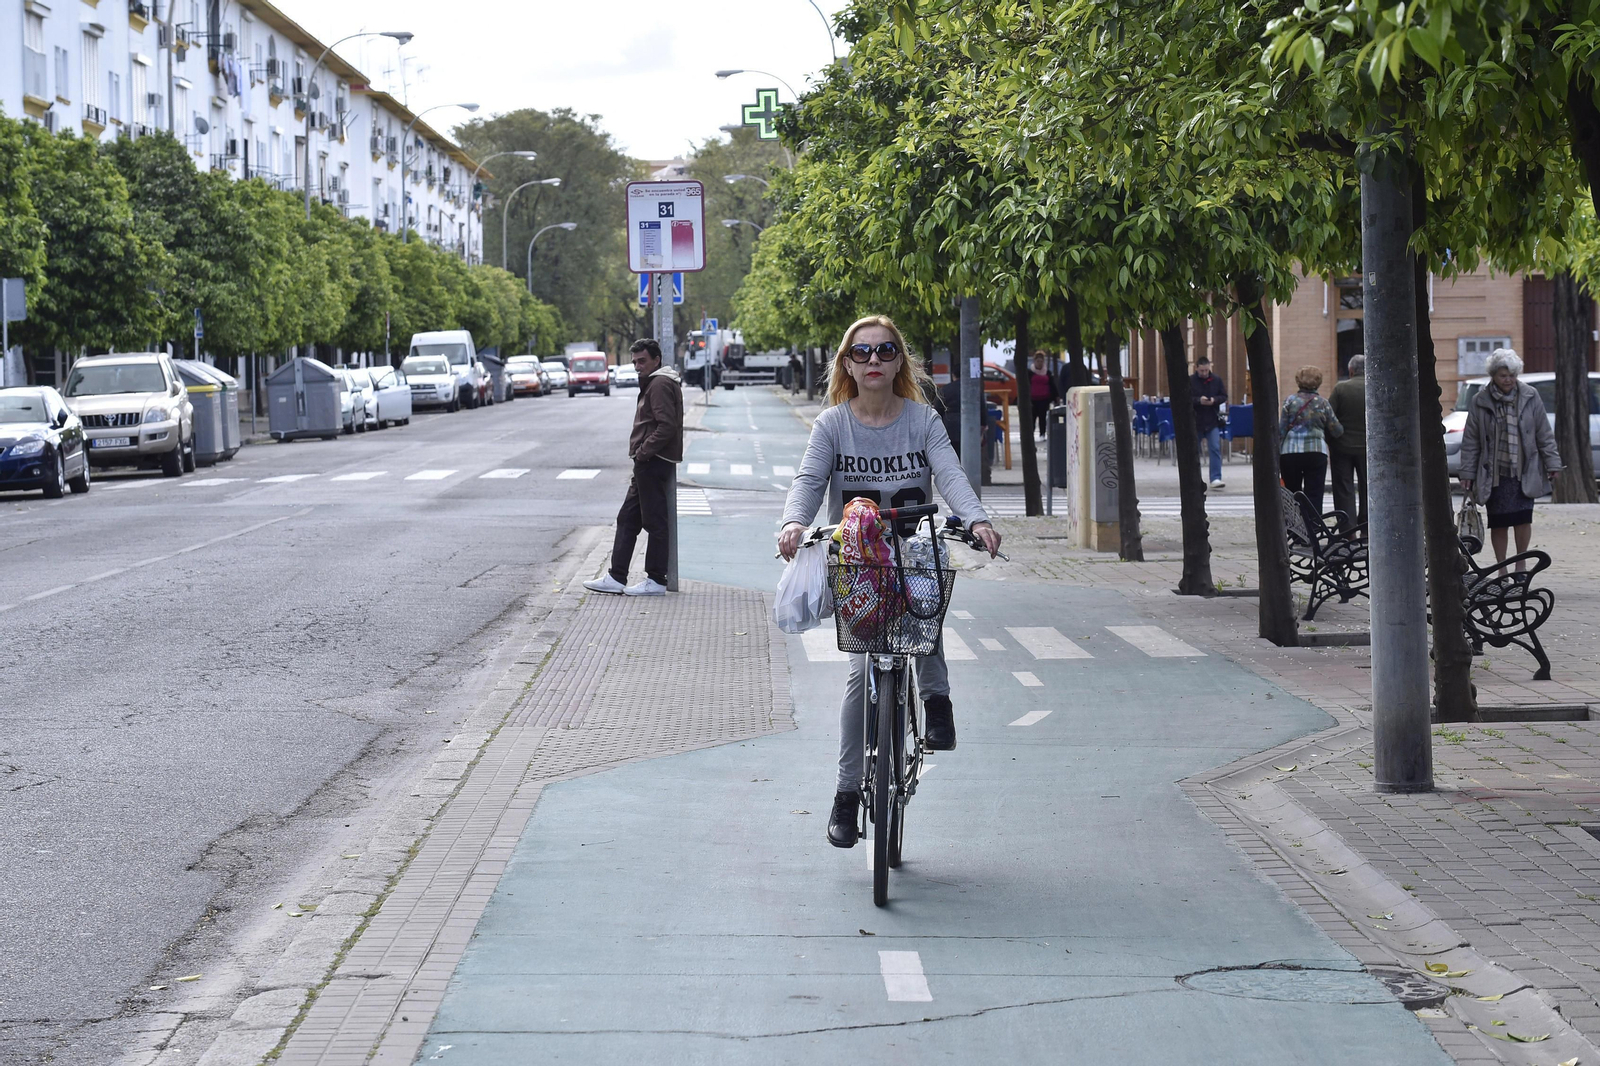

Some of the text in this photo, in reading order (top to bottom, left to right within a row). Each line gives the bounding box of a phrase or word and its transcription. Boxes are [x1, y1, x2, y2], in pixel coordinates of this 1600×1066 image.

[686, 187, 701, 196] 965
[660, 204, 673, 215] 31
[835, 449, 929, 474] BROOKLYN
[844, 471, 922, 483] REWYCRC ATLAADS
